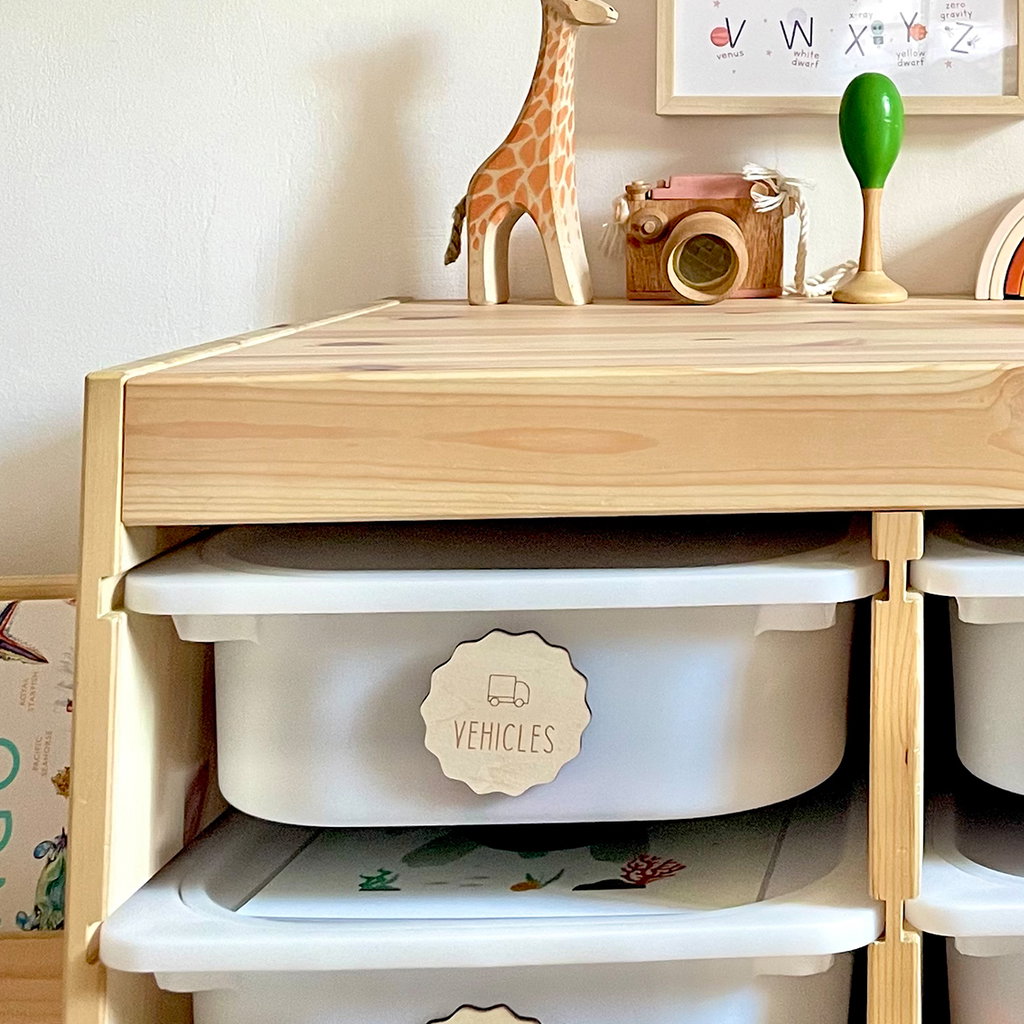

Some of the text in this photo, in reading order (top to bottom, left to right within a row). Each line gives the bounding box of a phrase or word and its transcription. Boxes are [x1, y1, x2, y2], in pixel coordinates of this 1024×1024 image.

[940, 10, 973, 21] gravity
[726, 12, 974, 56] V W X Y Z
[716, 49, 744, 60] venus
[794, 50, 820, 59] white
[896, 49, 925, 59] yellow
[792, 59, 820, 68] dwarf
[897, 59, 924, 67] dwarf
[454, 720, 555, 754] VEHICLES
